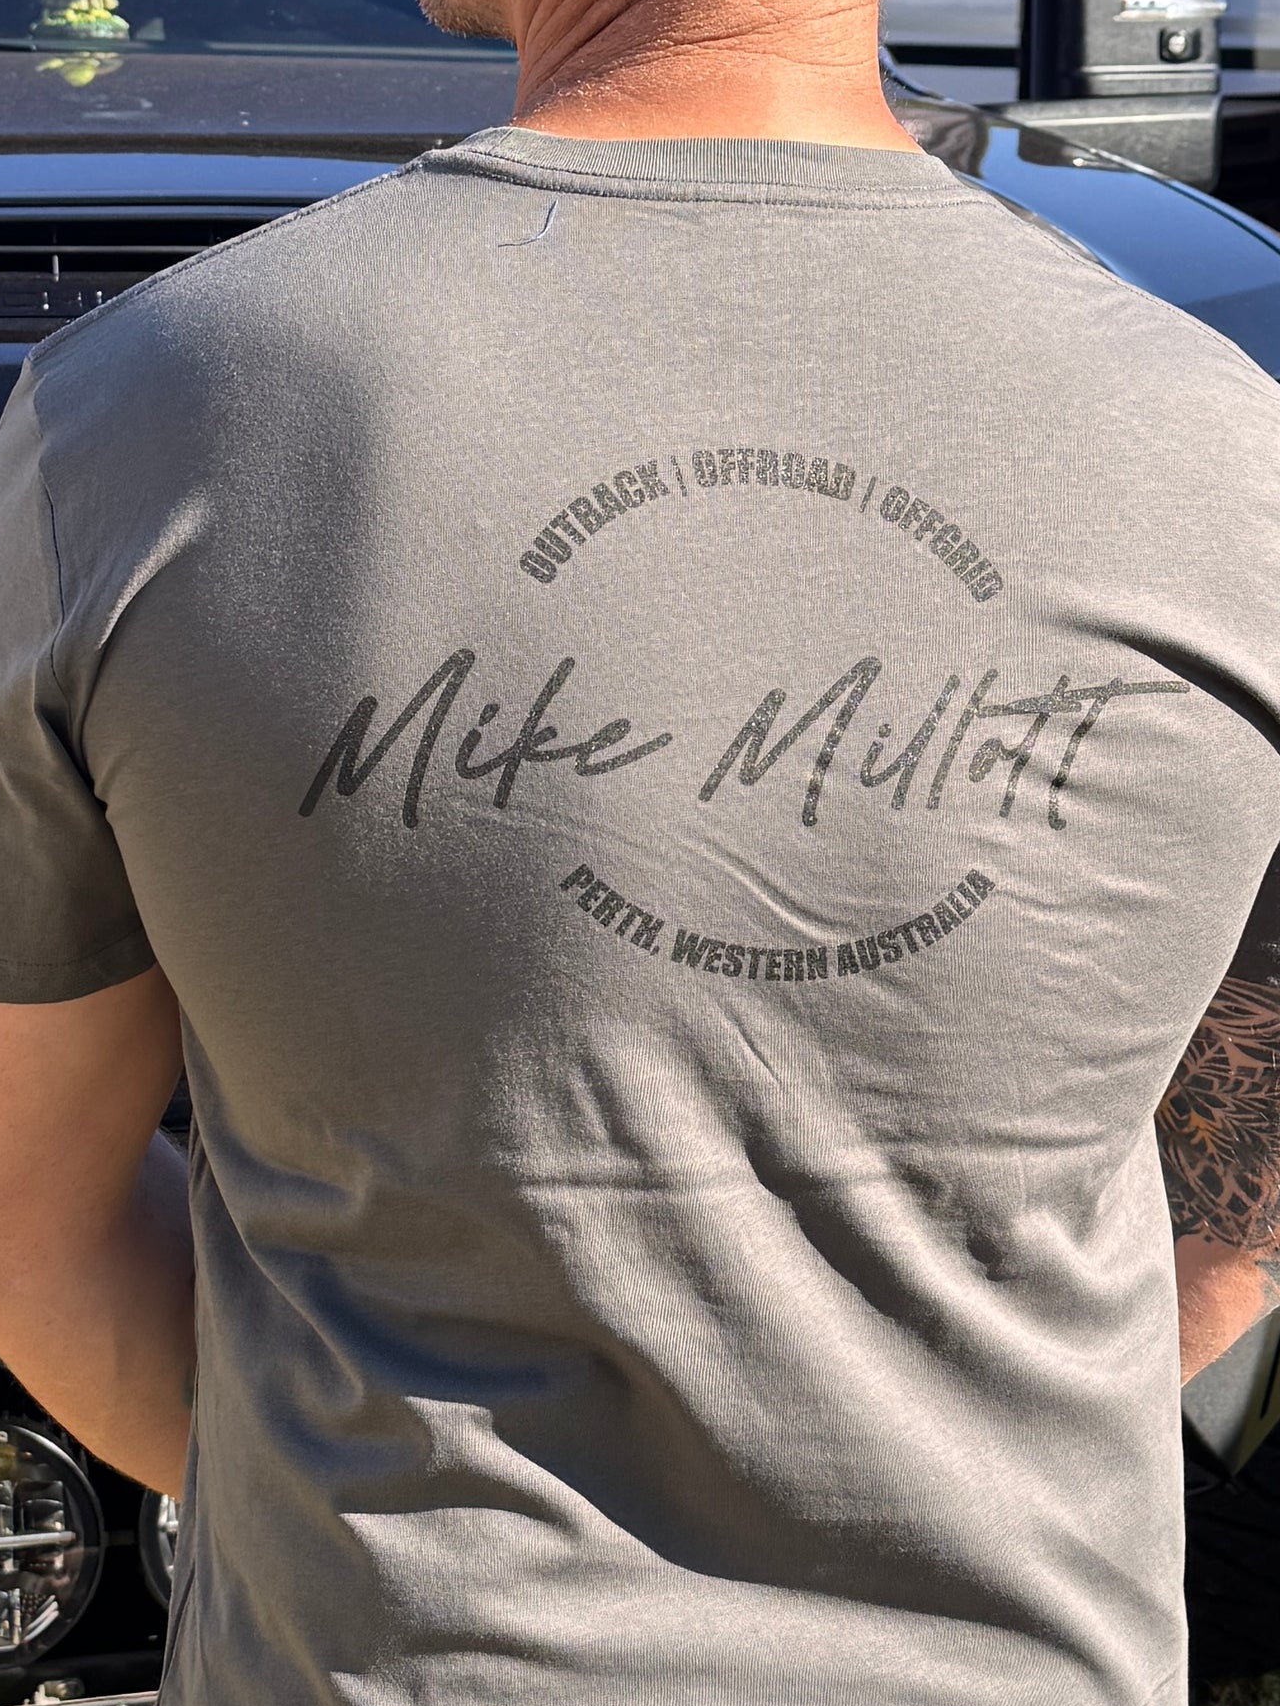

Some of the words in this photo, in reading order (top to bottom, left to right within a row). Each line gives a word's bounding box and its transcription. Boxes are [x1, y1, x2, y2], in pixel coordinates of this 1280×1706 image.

[519, 458, 672, 584] OUTBACK
[692, 447, 858, 502] OFFROAD
[879, 484, 1006, 604] OFFGRID
[298, 647, 674, 829] Mike
[670, 928, 828, 982] WESTERN
[835, 867, 997, 977] AUSTRALIA
